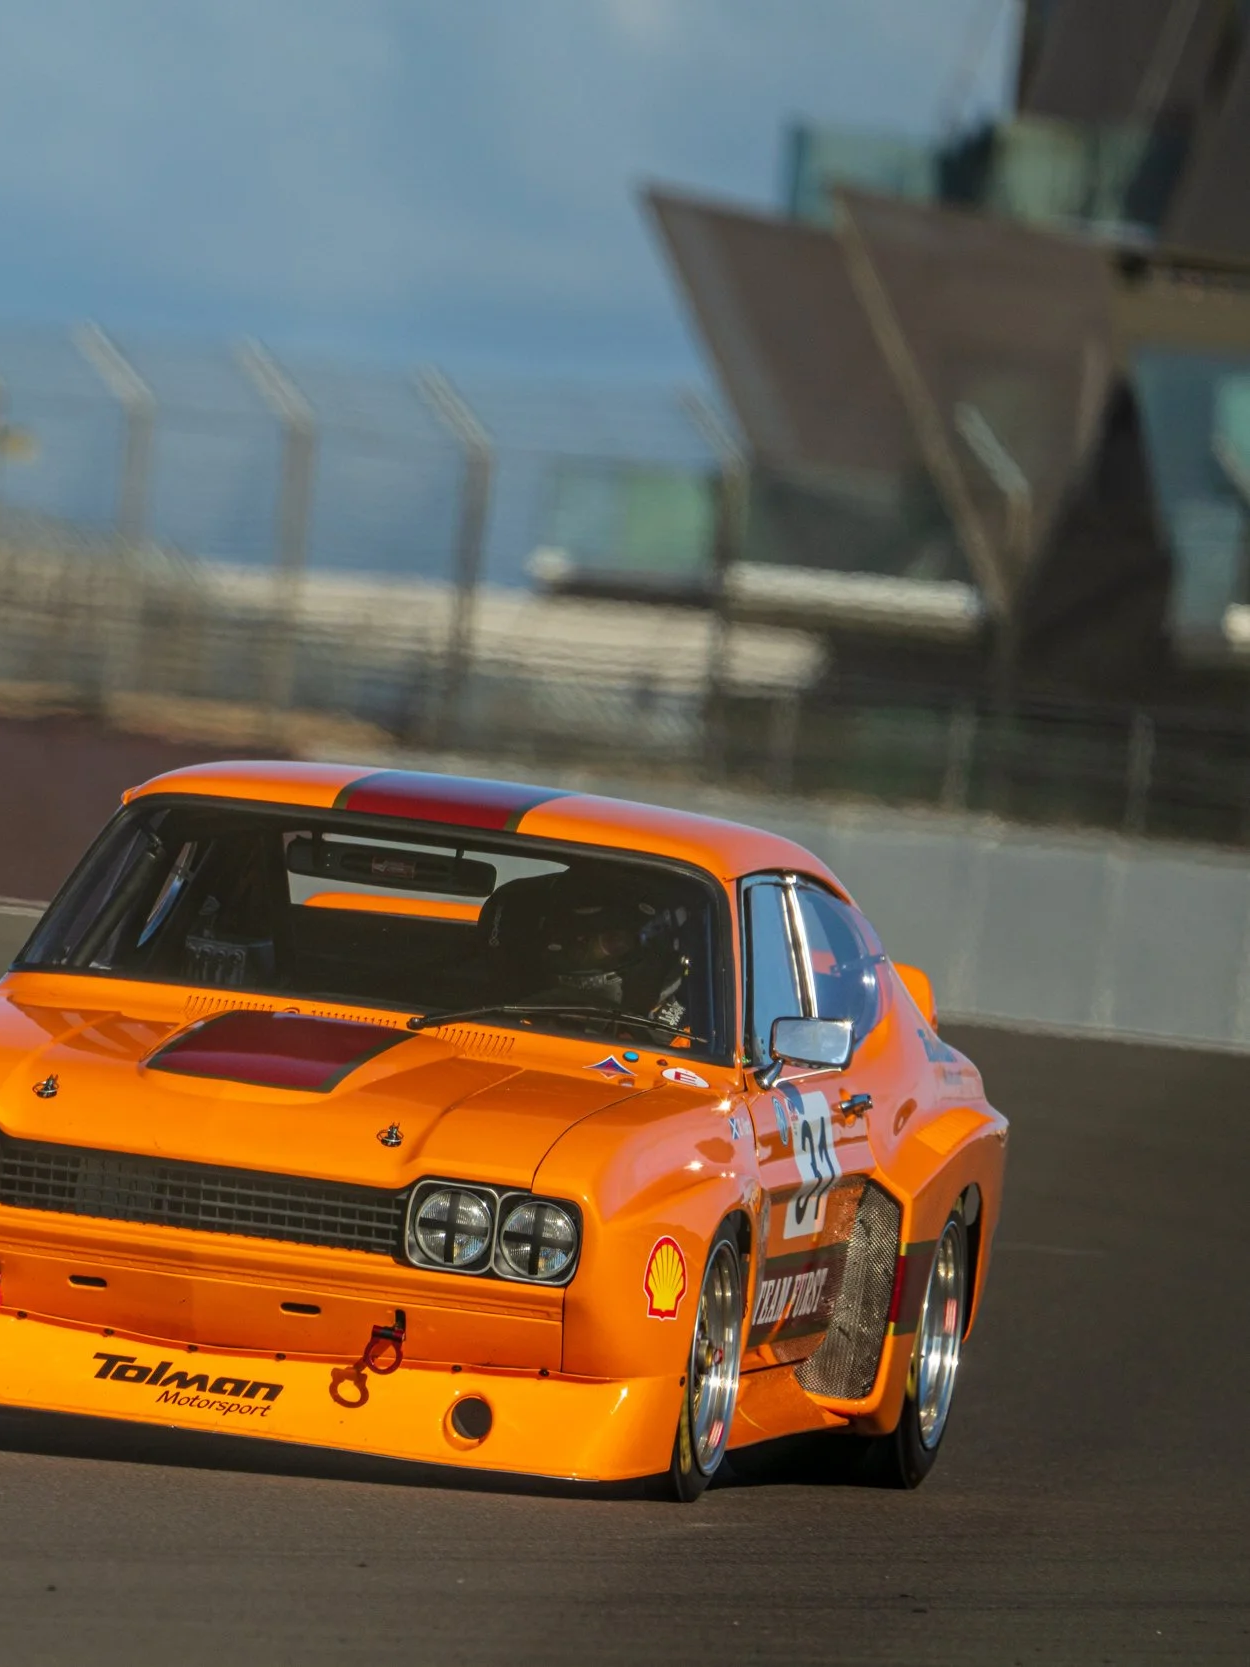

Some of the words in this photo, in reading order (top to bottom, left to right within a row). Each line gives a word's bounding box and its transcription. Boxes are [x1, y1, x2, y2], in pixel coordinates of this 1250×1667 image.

[795, 1116, 835, 1225] 31
[93, 1352, 284, 1402] Tolman
[155, 1390, 272, 1417] Motorsport
